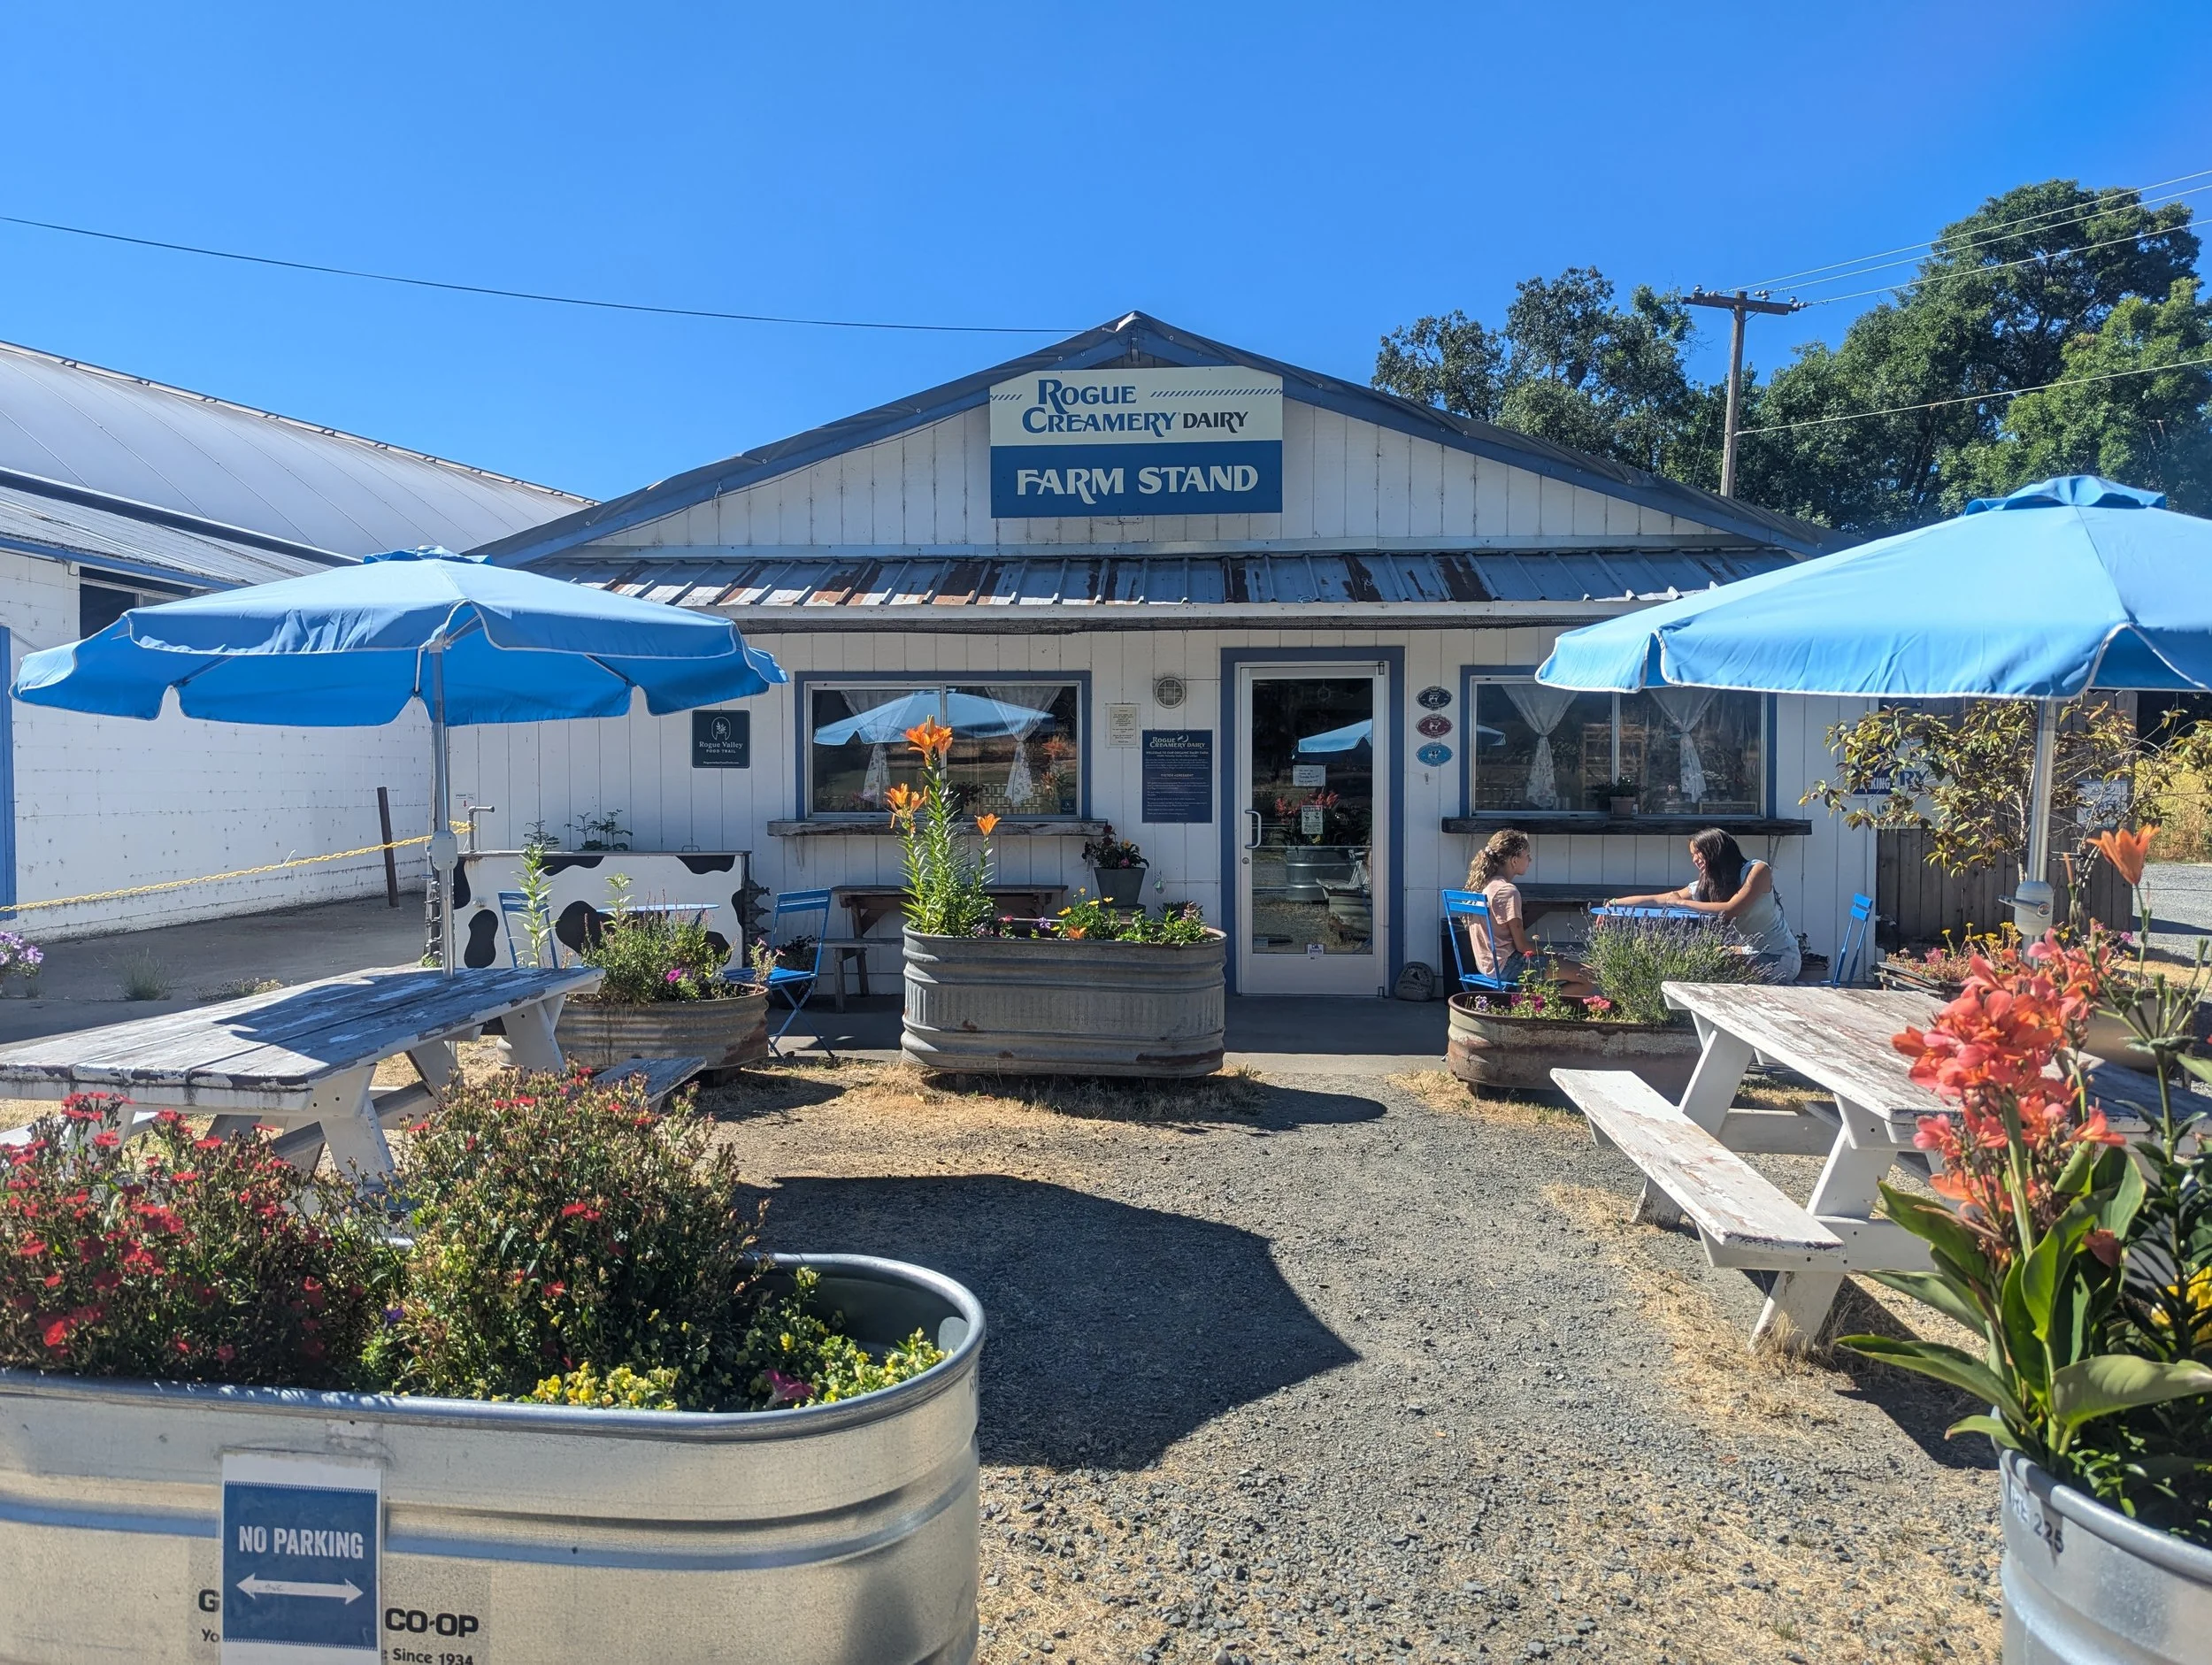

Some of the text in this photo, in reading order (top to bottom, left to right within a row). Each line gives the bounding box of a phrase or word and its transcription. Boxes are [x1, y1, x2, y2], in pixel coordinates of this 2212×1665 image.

[1038, 379, 1137, 414] ROGUE
[1022, 407, 1248, 437] CREAMERY DAIRY
[1017, 464, 1259, 504] FARM STAND
[238, 1525, 364, 1559] NO PARKING
[385, 1607, 479, 1638] CO-OP
[393, 1648, 433, 1664] Since
[438, 1653, 474, 1665] 1934
